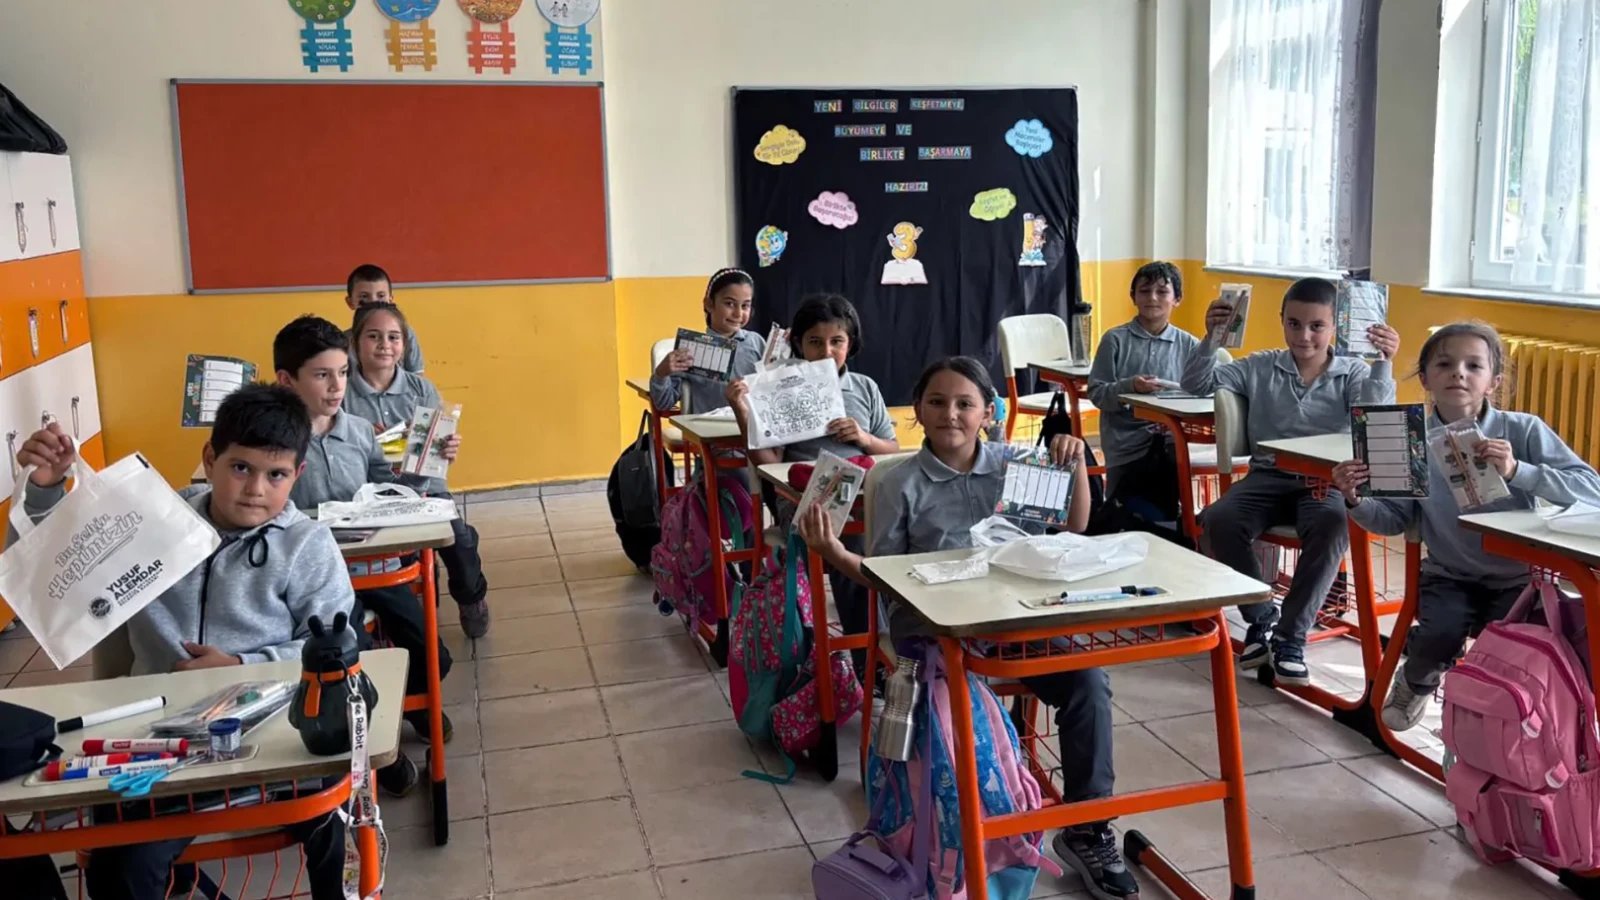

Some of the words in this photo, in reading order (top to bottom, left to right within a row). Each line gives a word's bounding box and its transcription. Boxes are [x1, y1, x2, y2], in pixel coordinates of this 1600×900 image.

[814, 100, 842, 112] YENİ
[853, 99, 898, 112] BİLGİLER
[834, 124, 886, 136] BÜYÜMEYE
[895, 124, 912, 135] VE
[860, 148, 905, 161] BİRLİKTE
[918, 146, 971, 159] BAŞARMAYA
[49, 510, 143, 600] Hepimizin
[106, 563, 141, 593] YUSUF
[114, 559, 163, 601] ALEMDAR
[355, 717, 363, 750] Rabbit
